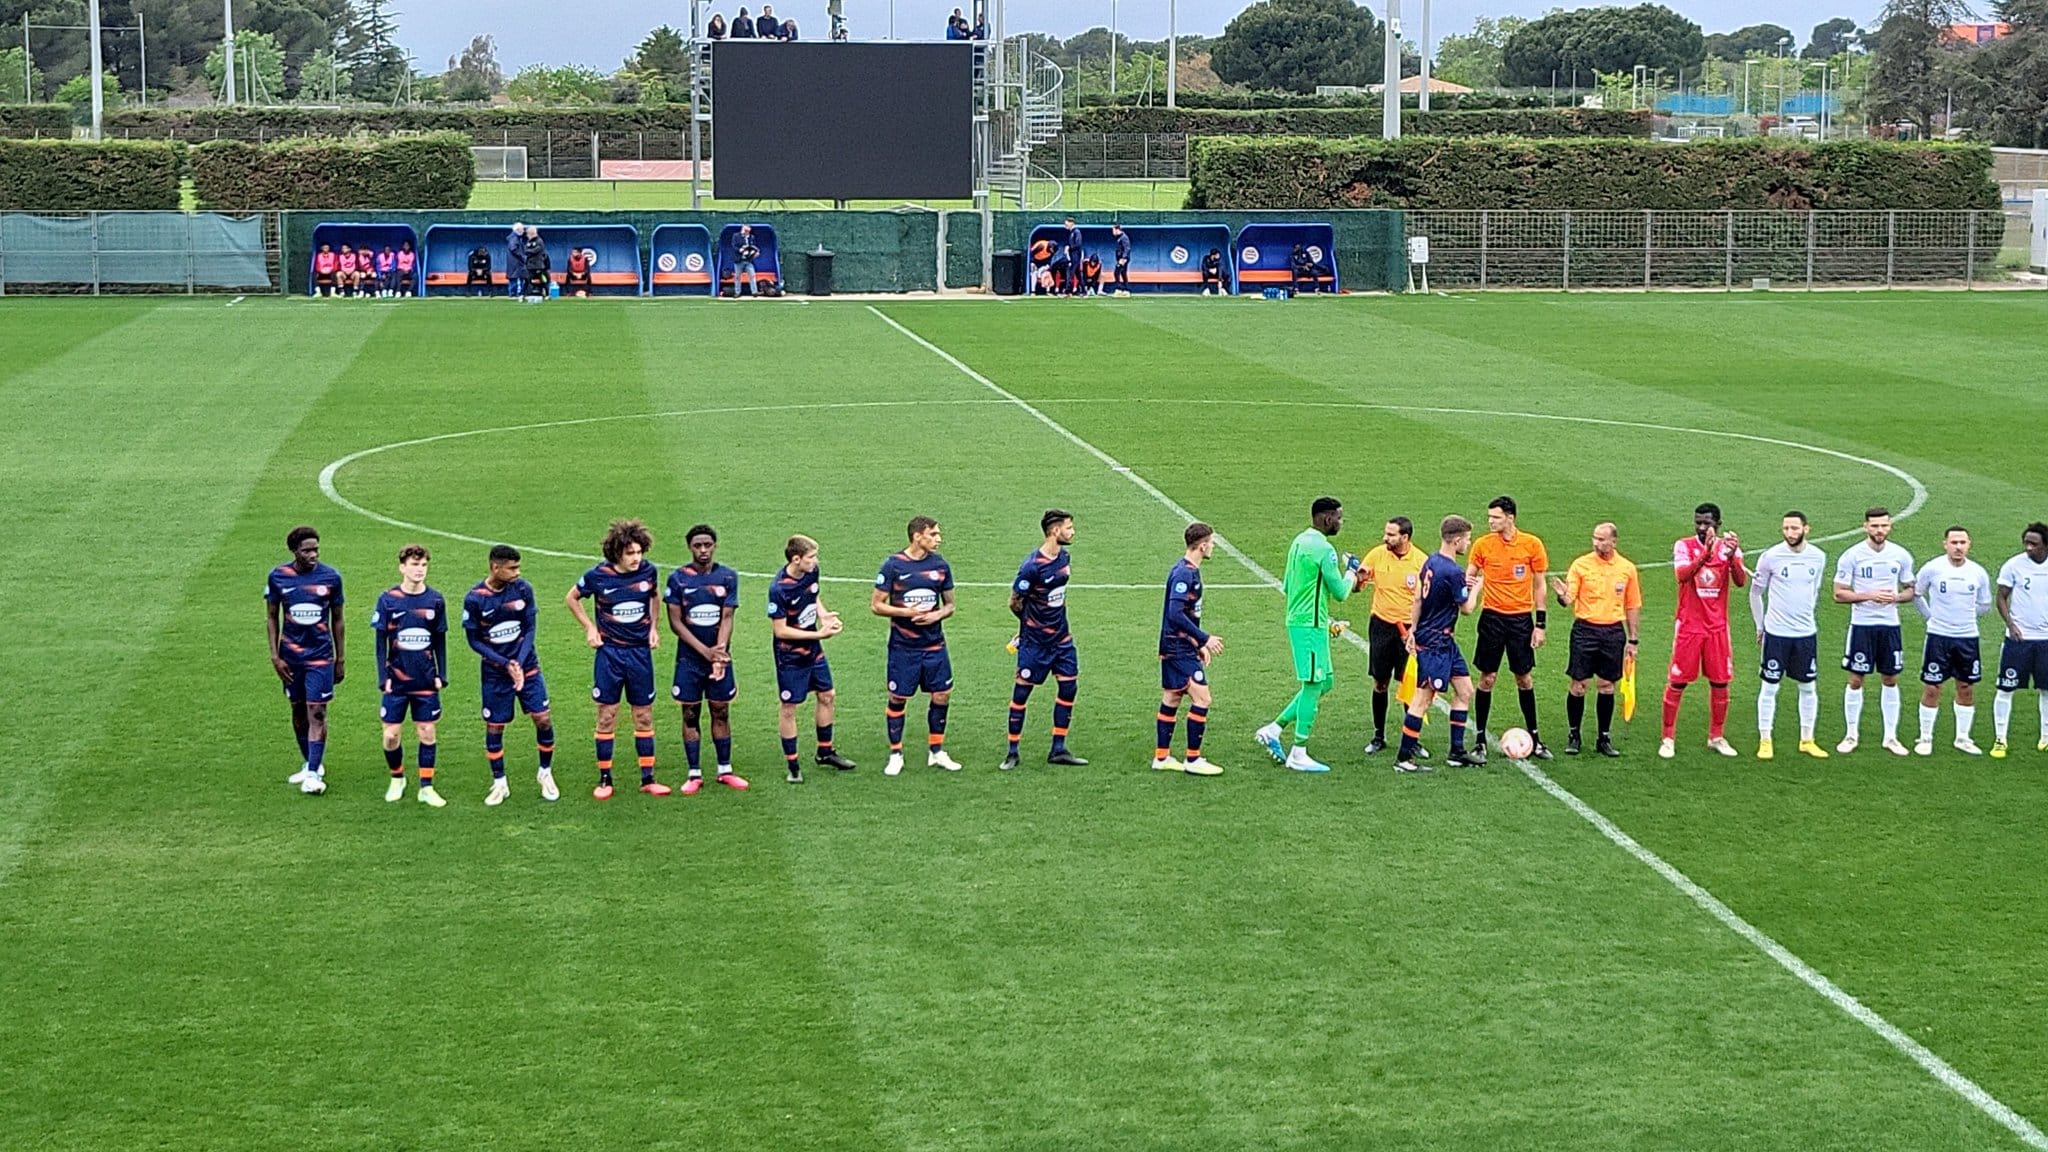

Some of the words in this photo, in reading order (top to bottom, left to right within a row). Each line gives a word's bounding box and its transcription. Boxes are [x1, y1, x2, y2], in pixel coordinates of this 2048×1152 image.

[1781, 567, 1788, 578] 4
[1861, 566, 1872, 578] 10
[1940, 581, 1947, 593] 8
[2024, 578, 2031, 590] 2
[1972, 660, 1980, 674] 8
